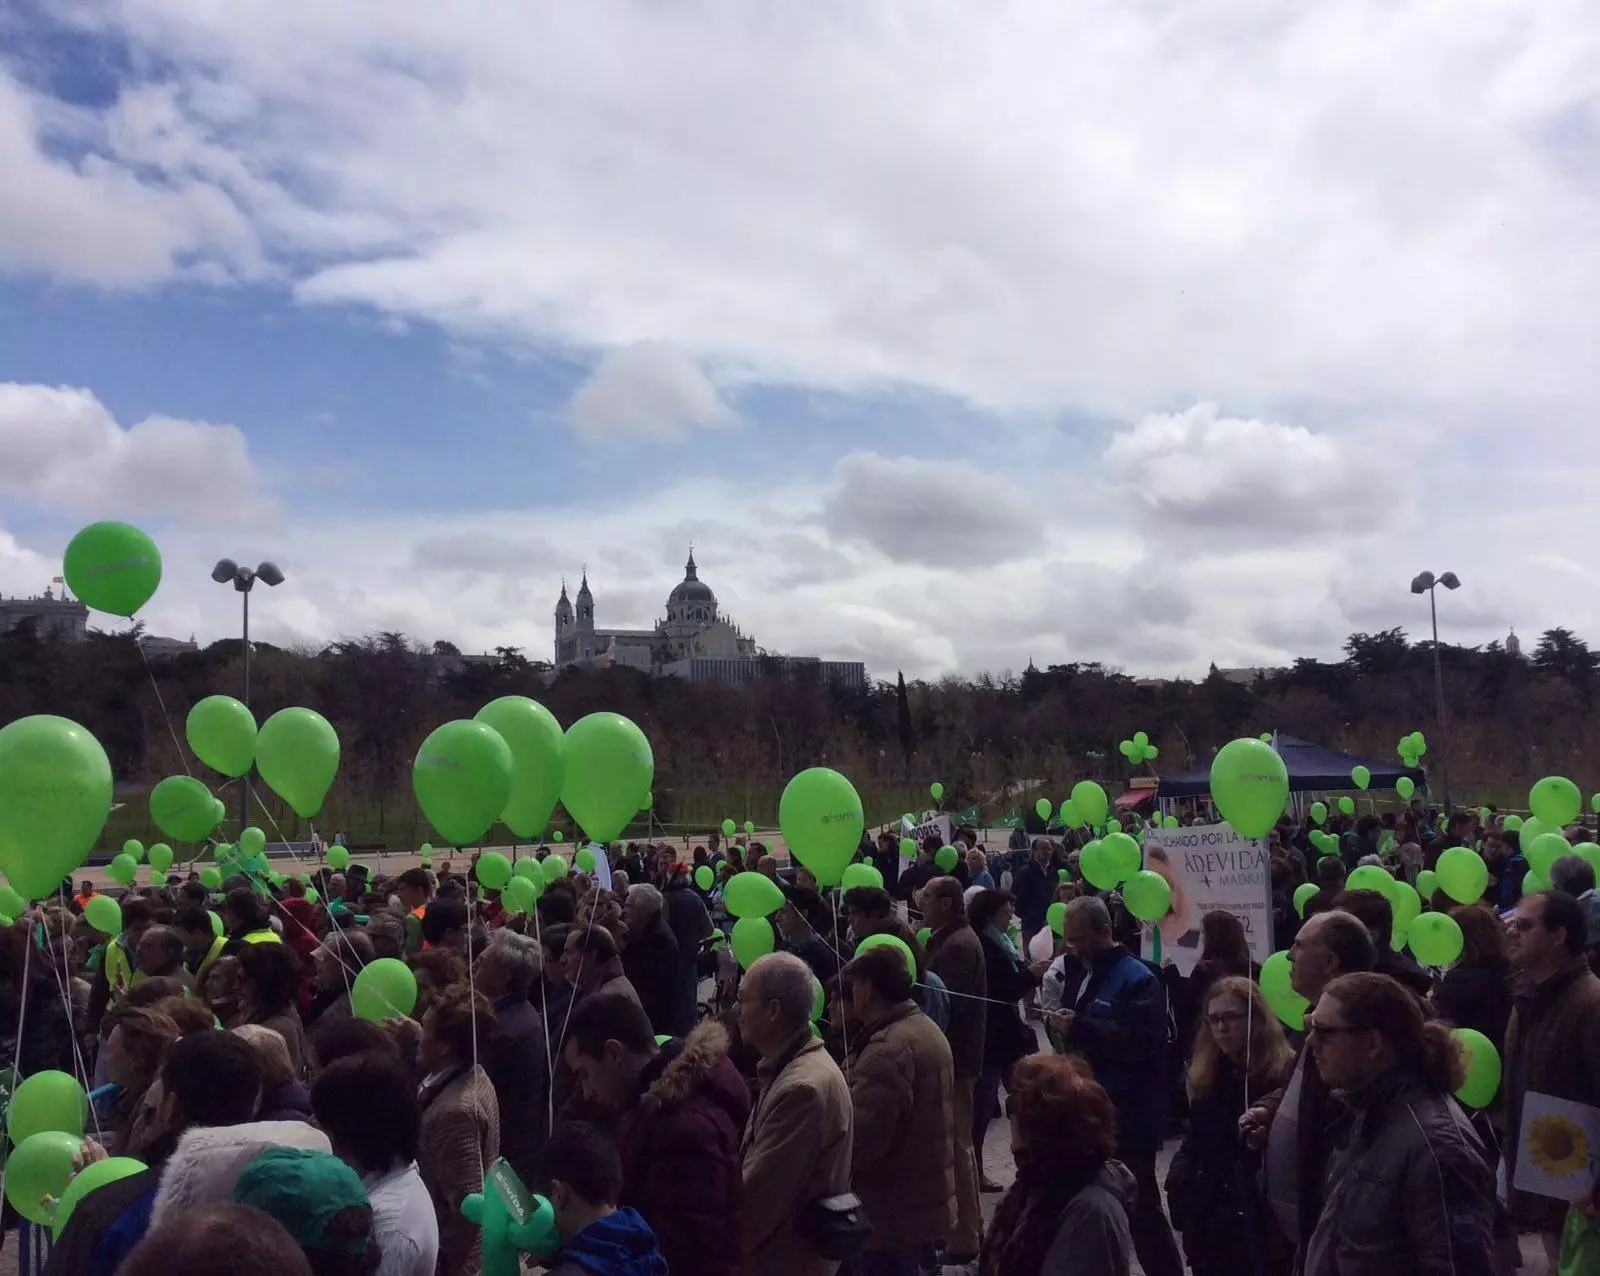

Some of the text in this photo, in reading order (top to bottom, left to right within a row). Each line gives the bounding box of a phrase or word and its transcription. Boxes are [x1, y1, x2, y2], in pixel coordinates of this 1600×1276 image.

[1201, 832, 1223, 845] POR
[1226, 831, 1238, 843] LA
[1184, 850, 1265, 872] ADEVIDA
